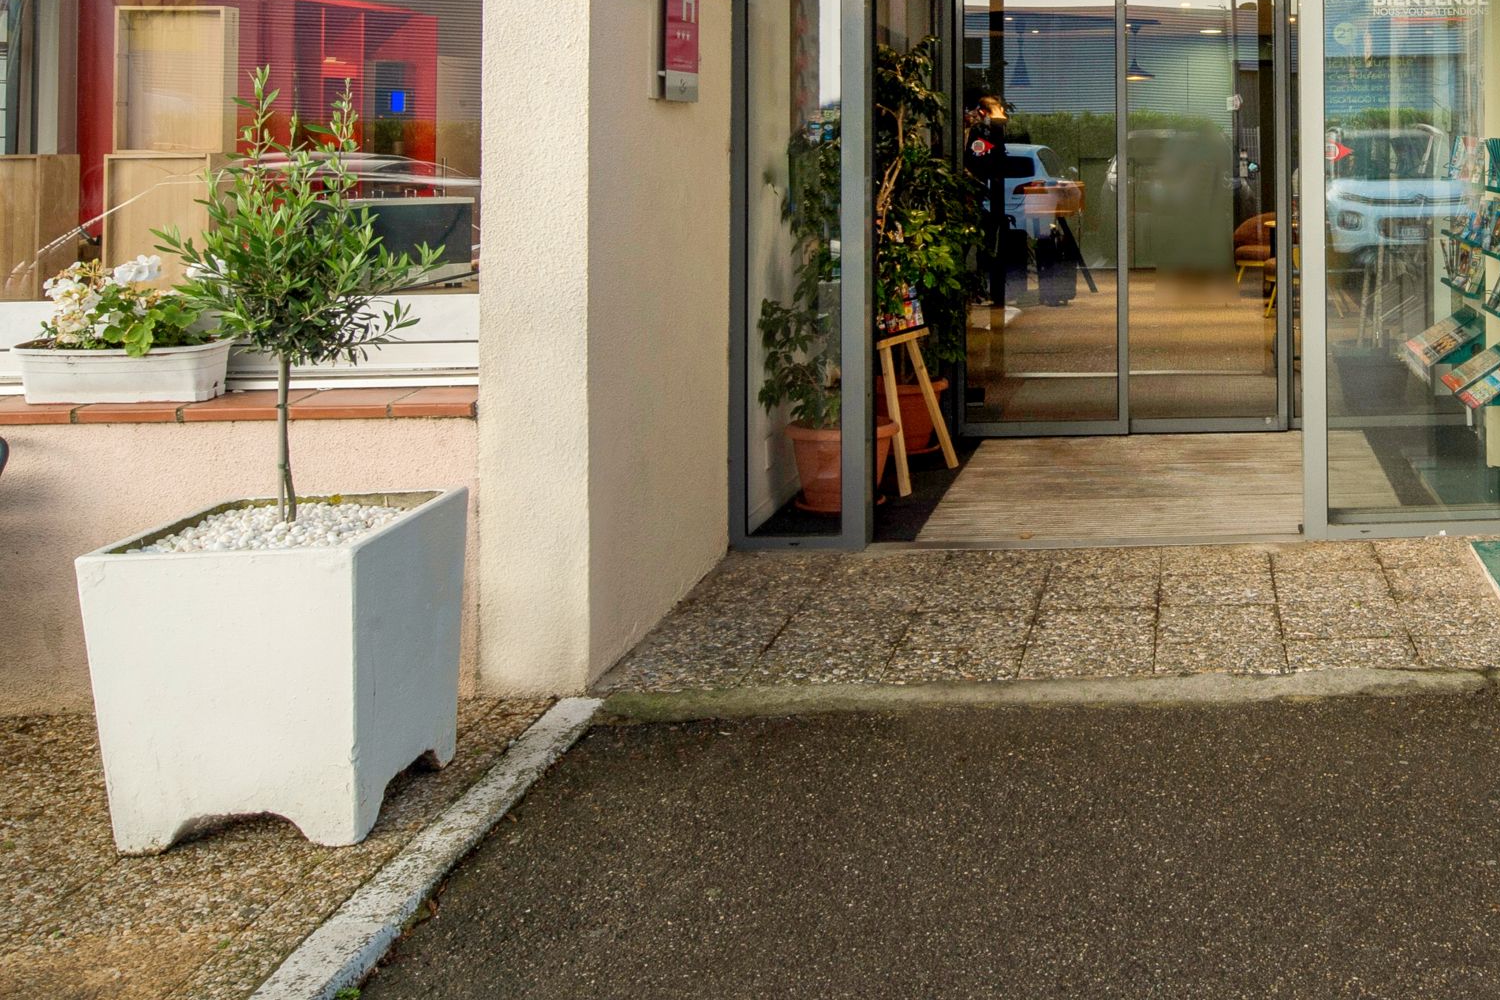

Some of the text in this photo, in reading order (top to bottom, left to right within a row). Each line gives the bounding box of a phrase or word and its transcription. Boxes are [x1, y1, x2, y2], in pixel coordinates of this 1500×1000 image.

[1372, 7, 1489, 16] NOUS VOUS ATTENDIONS
